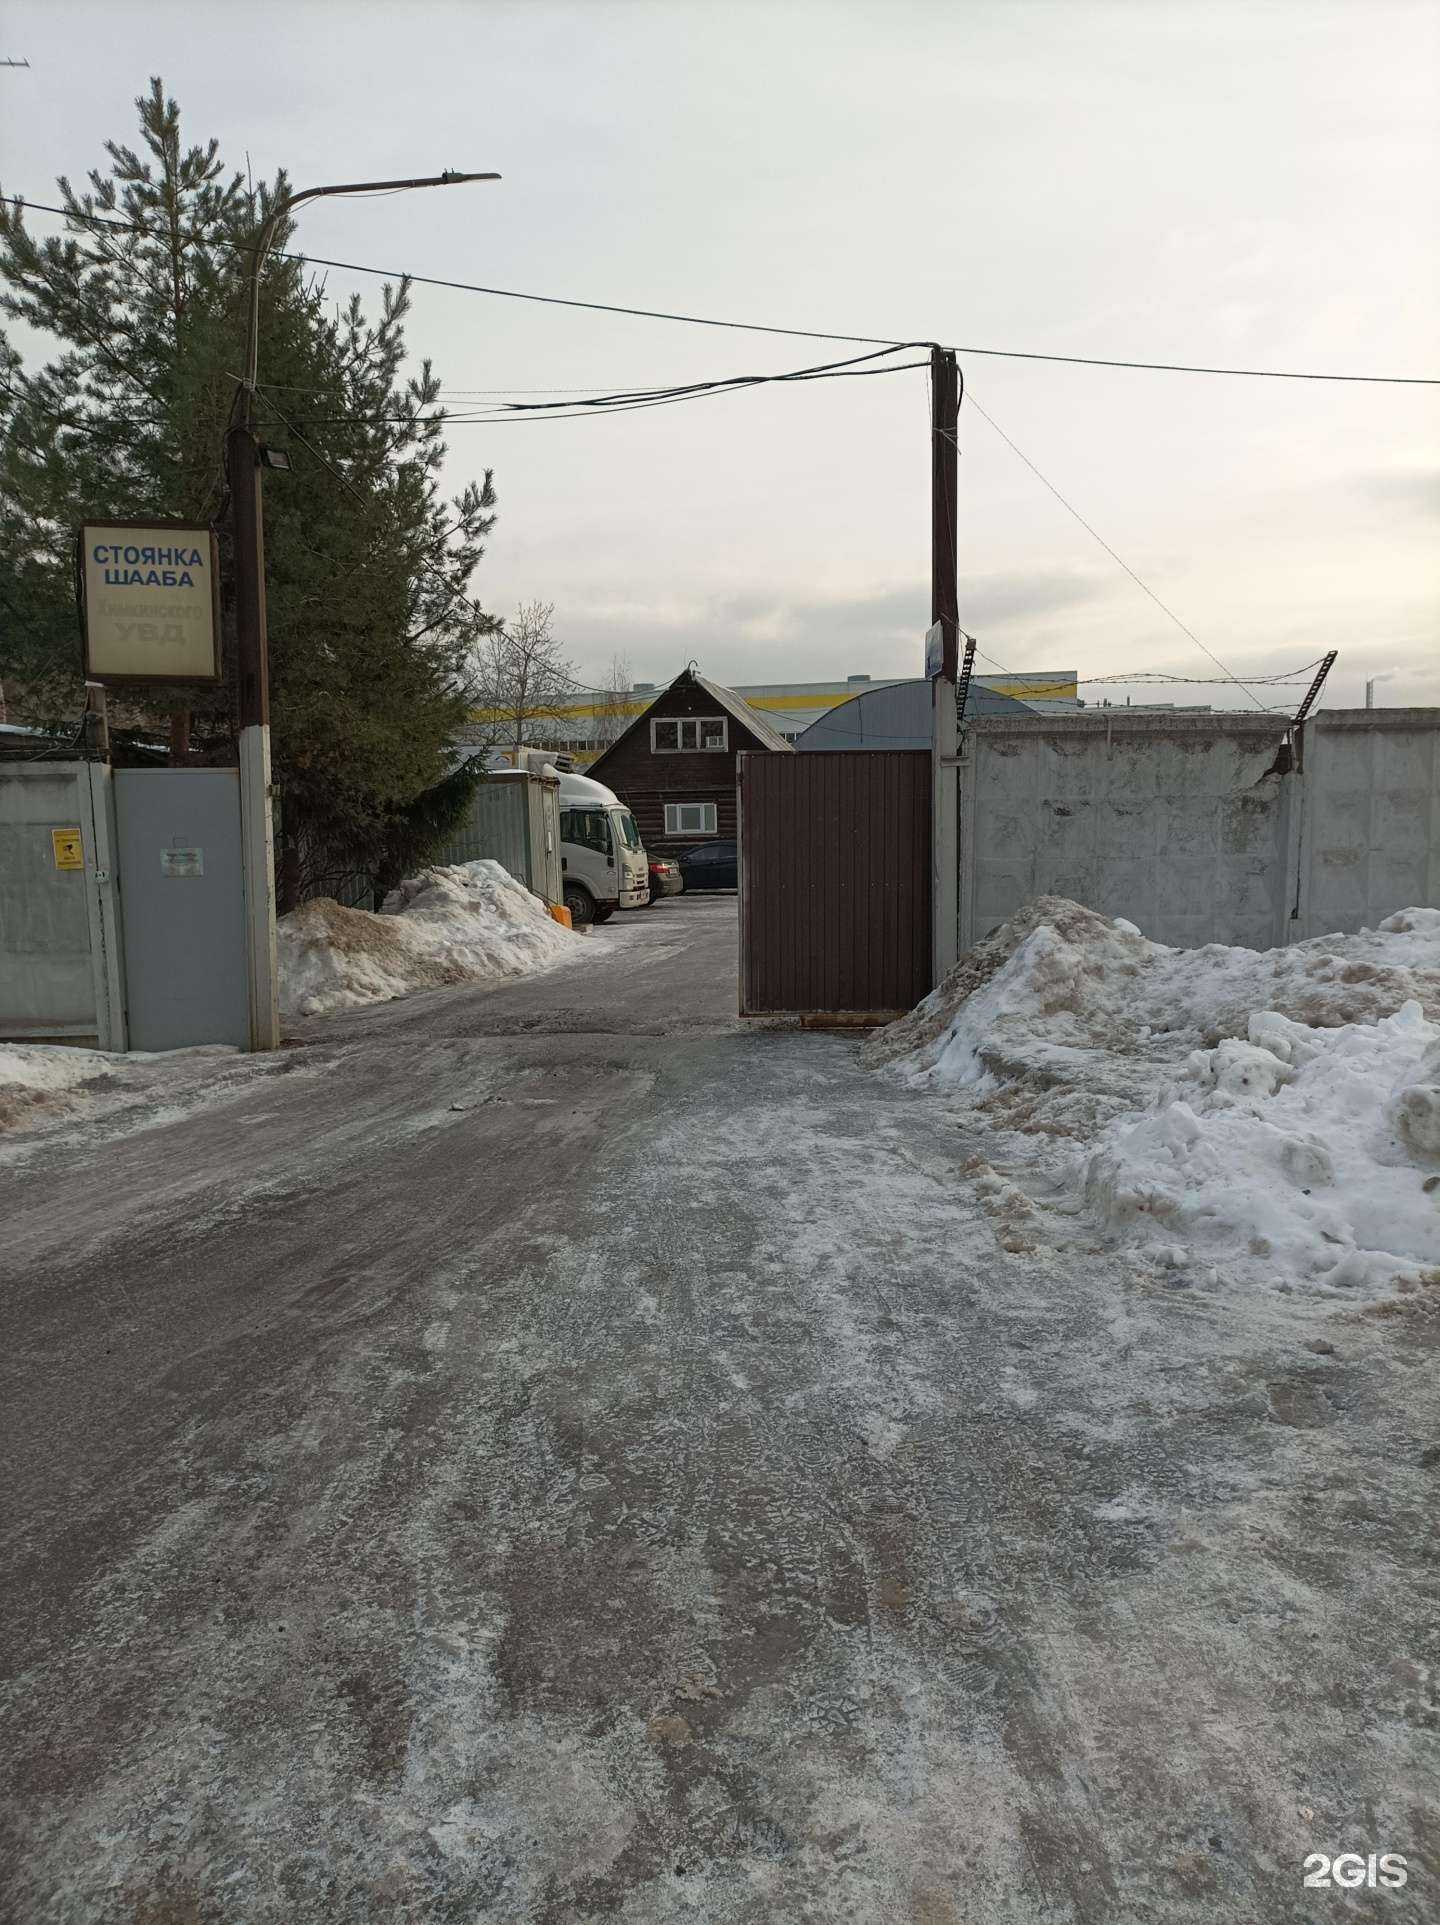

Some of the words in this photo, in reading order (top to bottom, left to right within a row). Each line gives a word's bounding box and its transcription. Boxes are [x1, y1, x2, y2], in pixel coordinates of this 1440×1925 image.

[93, 545, 203, 566] СТОЯНКА
[104, 568, 194, 587] ШААБА
[114, 622, 187, 646] УВД
